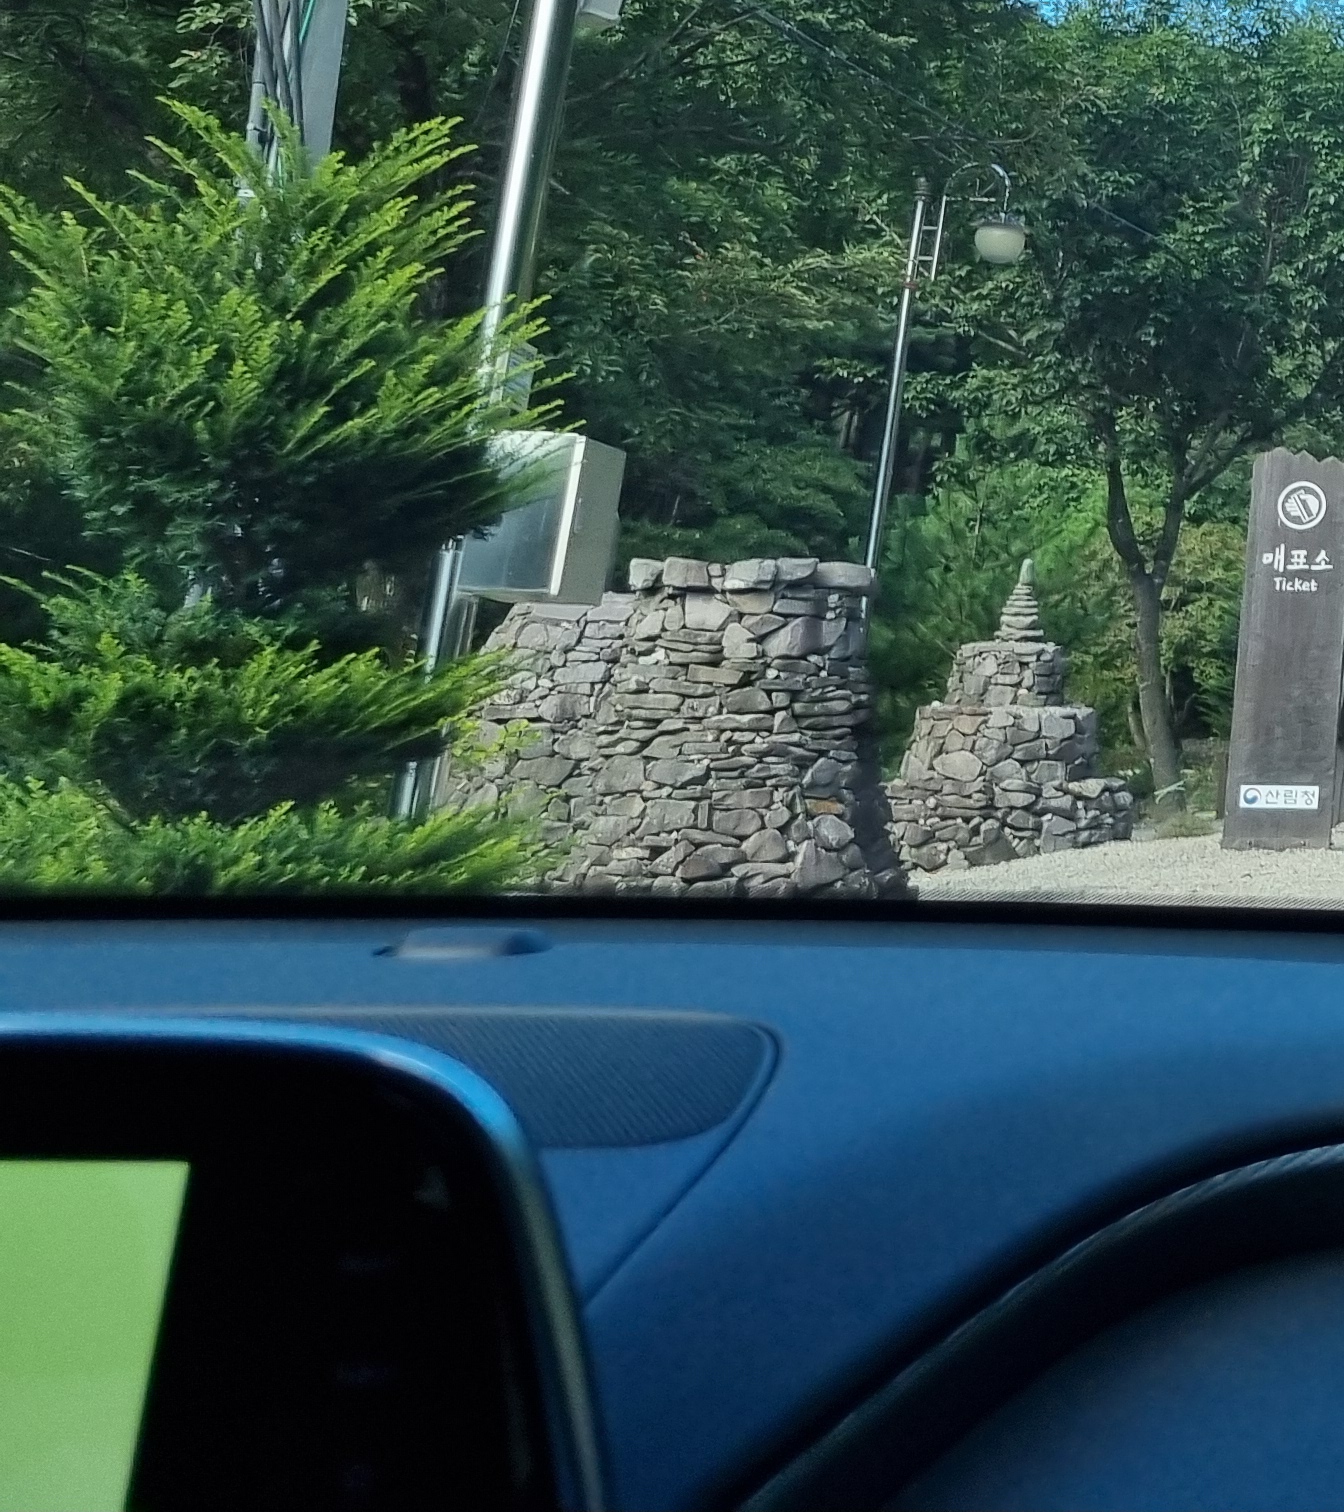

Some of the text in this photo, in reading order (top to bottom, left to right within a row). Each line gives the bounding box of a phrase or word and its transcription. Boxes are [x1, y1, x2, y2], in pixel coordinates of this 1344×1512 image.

[1262, 543, 1334, 573] 매표소
[1273, 577, 1319, 593] Ticket
[1265, 789, 1316, 806] 산림청
